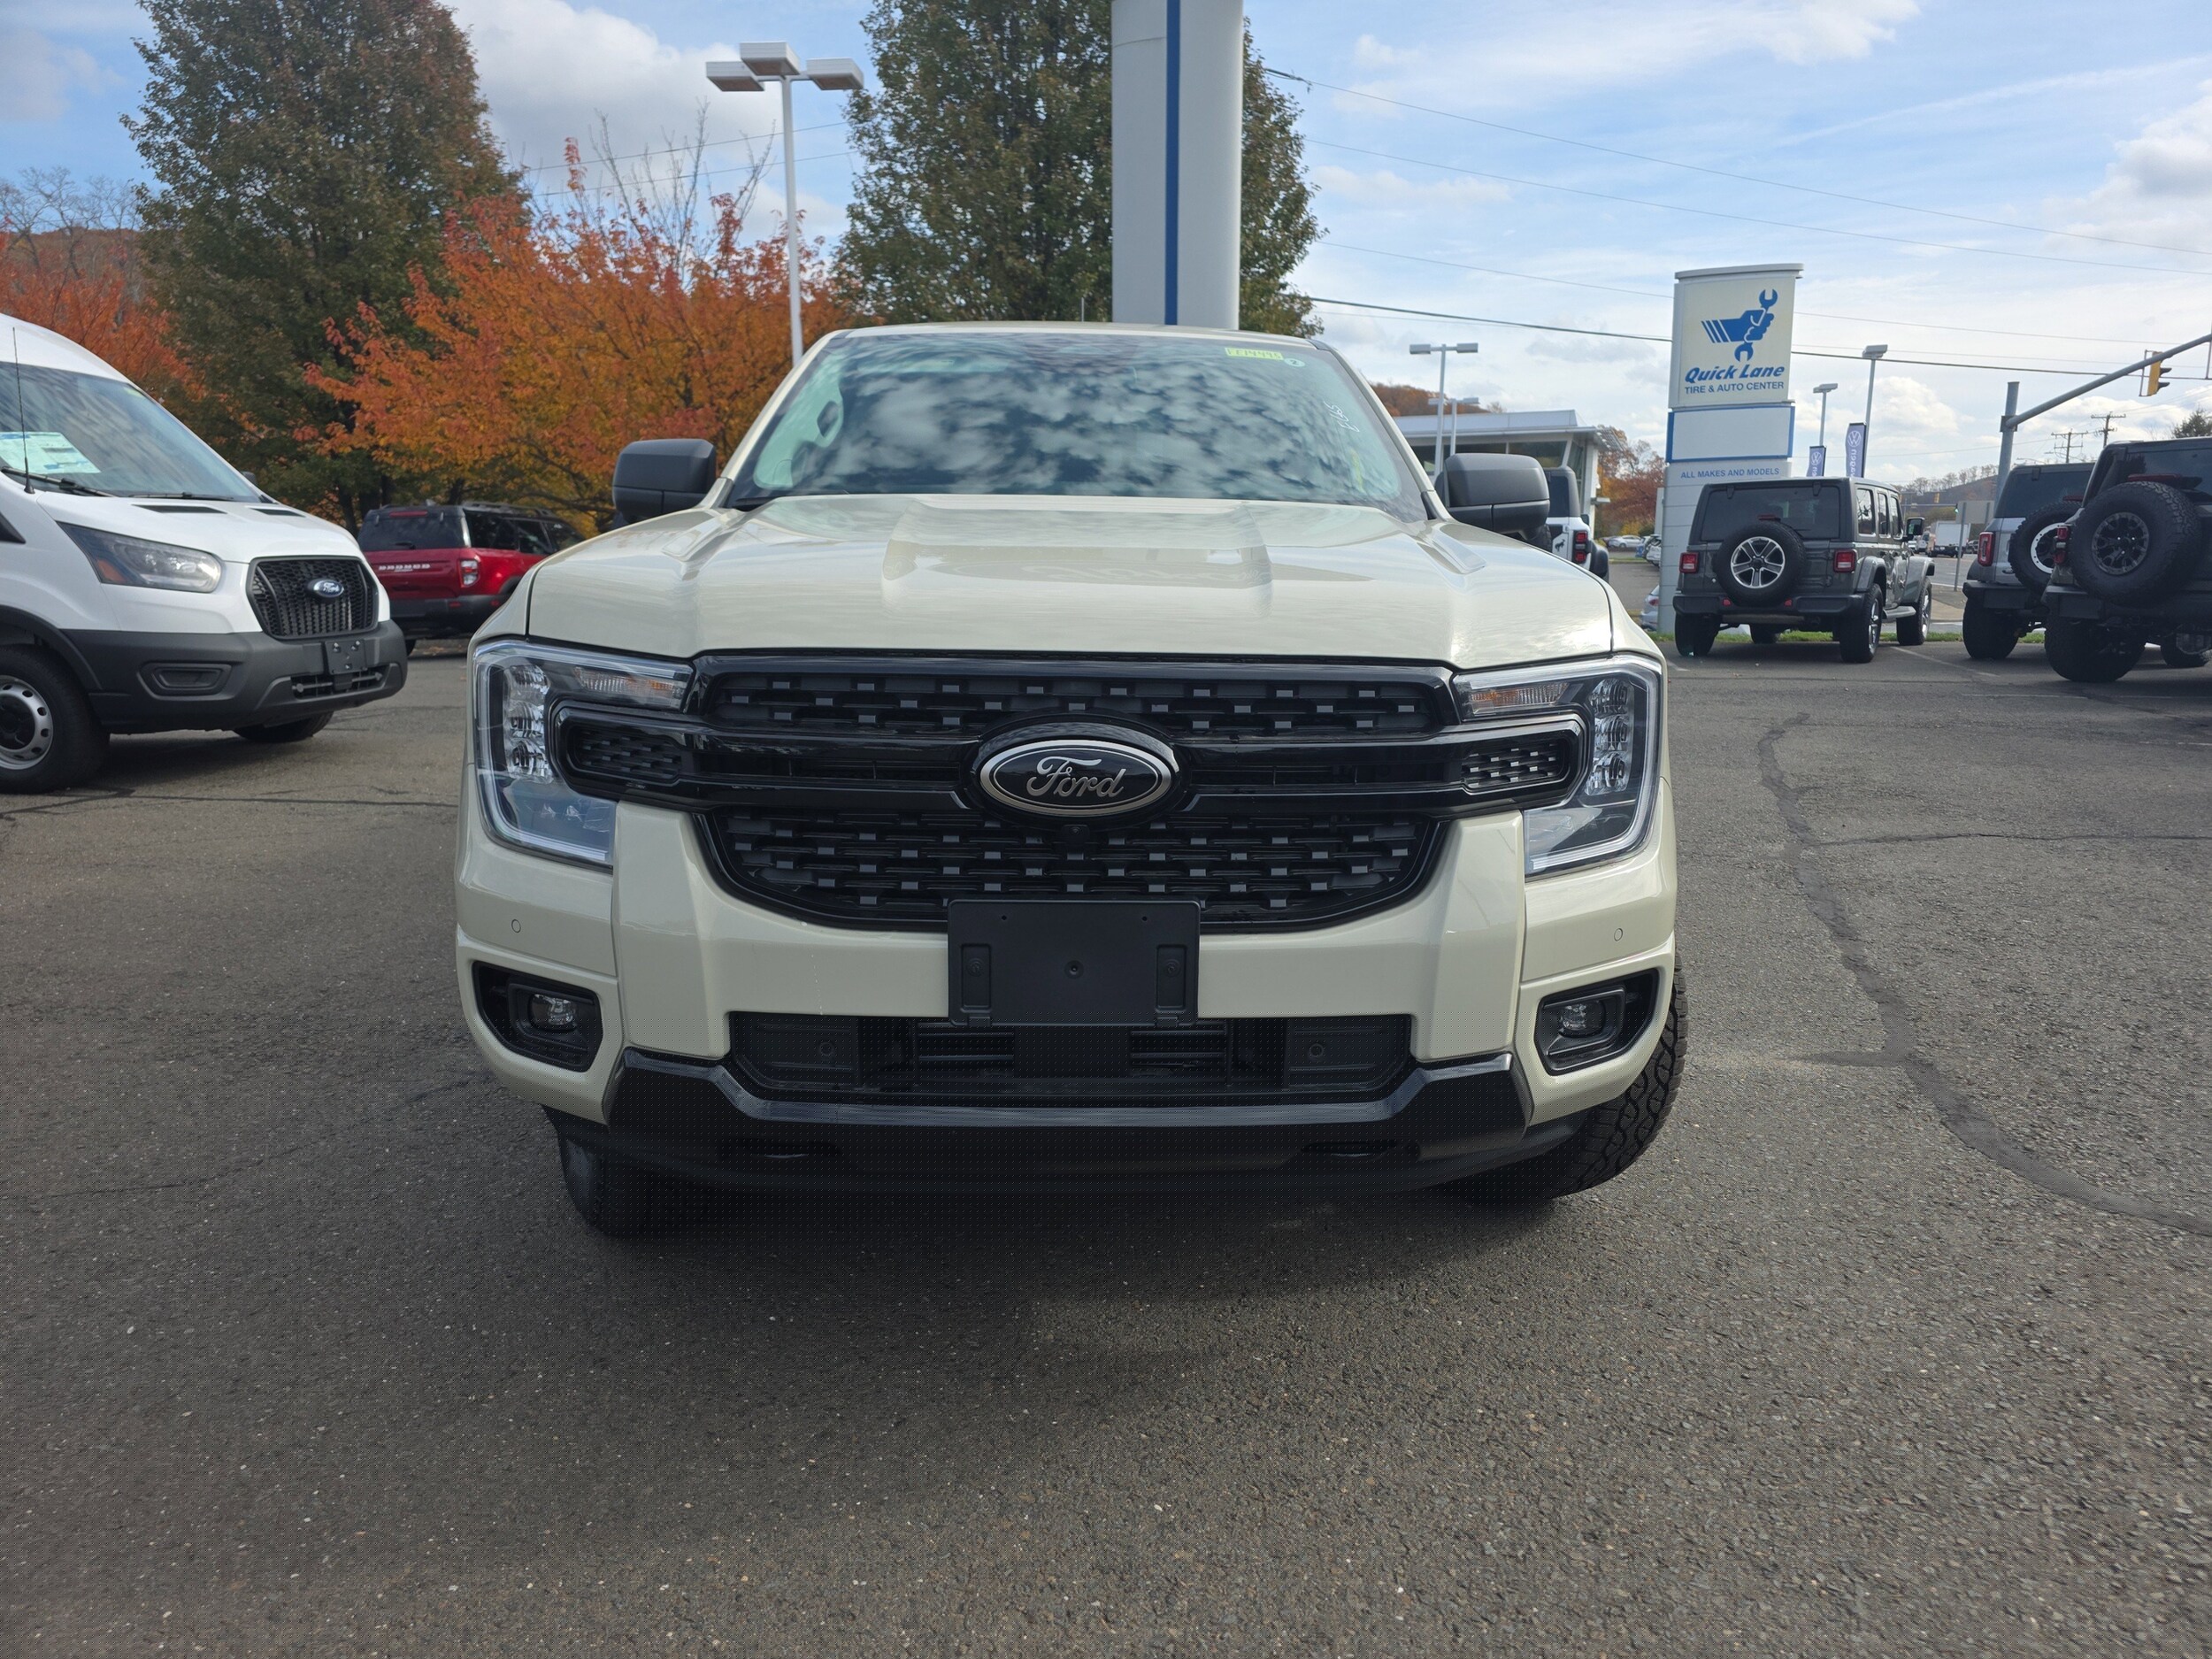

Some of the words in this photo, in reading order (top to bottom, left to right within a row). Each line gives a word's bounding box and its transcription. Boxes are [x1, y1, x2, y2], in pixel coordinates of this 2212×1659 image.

[1685, 365, 1738, 383] Quick
[1739, 364, 1785, 379] Lane
[1685, 385, 1706, 394] TIRE
[1717, 383, 1744, 392] AUTO
[1747, 381, 1784, 390] CENTER
[1026, 756, 1127, 797] Ford
